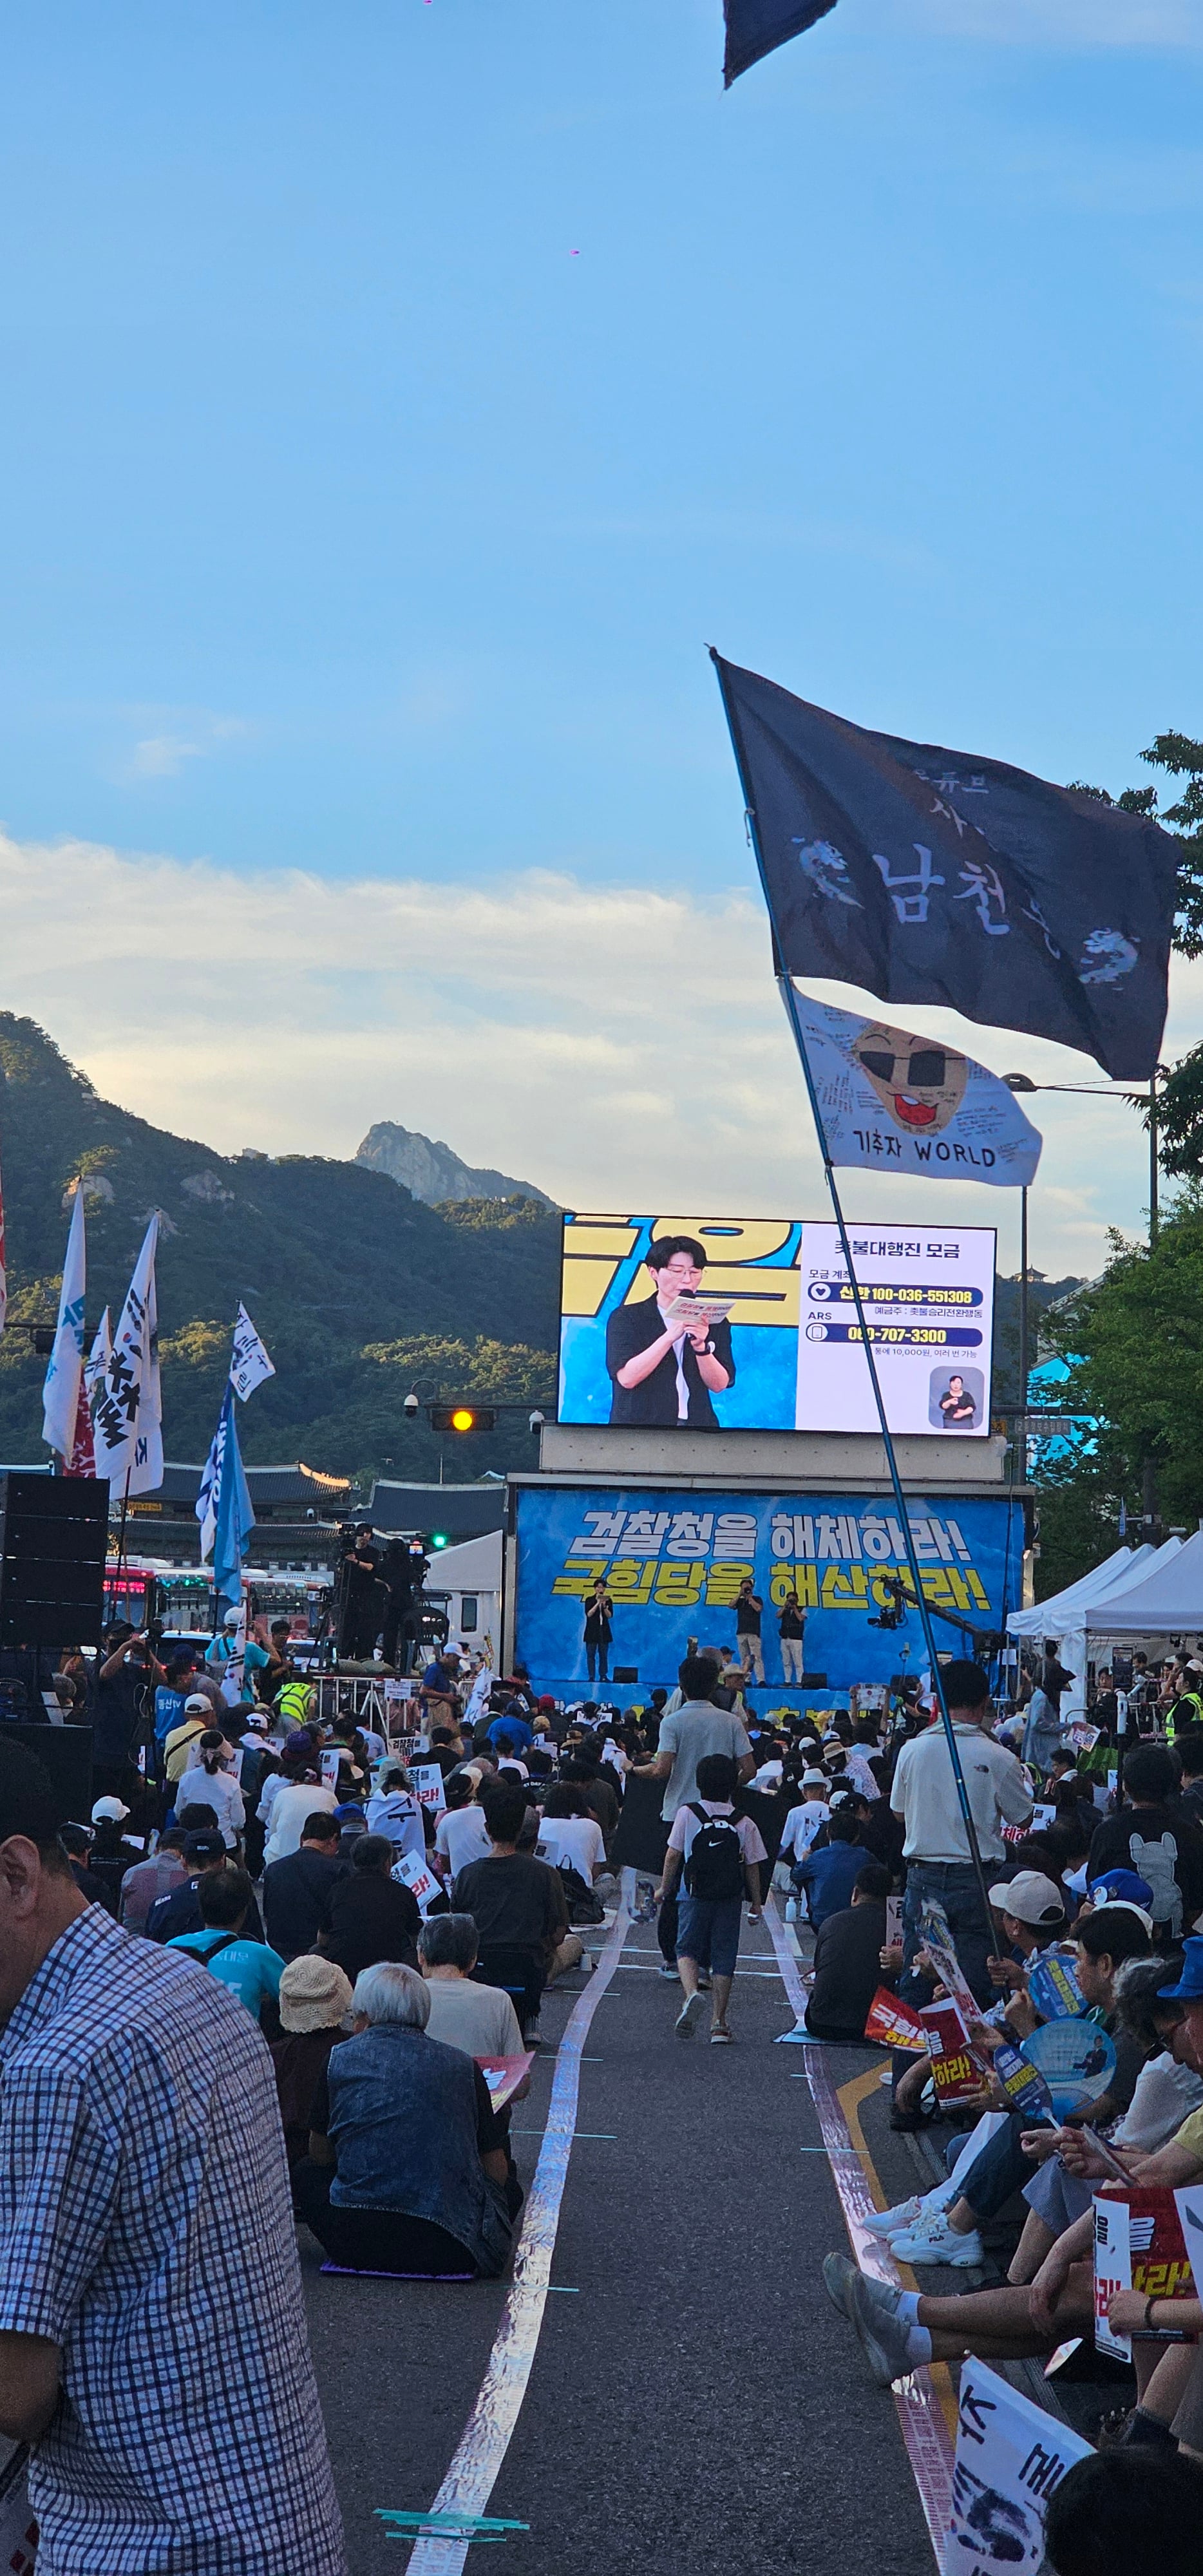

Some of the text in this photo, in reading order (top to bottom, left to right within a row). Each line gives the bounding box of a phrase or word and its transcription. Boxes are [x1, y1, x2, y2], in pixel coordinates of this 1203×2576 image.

[914, 1140, 996, 1168] WORLD
[926, 1244, 960, 1258] 모금
[809, 1269, 830, 1279] 모금
[872, 1288, 972, 1303] 100-036-551308
[808, 1312, 832, 1320] ARS
[875, 1307, 902, 1315] 예금주
[910, 1307, 983, 1318] 촛불승리전환행동
[569, 1510, 972, 1562] 검찰청을 해체하라!
[552, 1559, 992, 1611] 국힘당을 해산하라!
